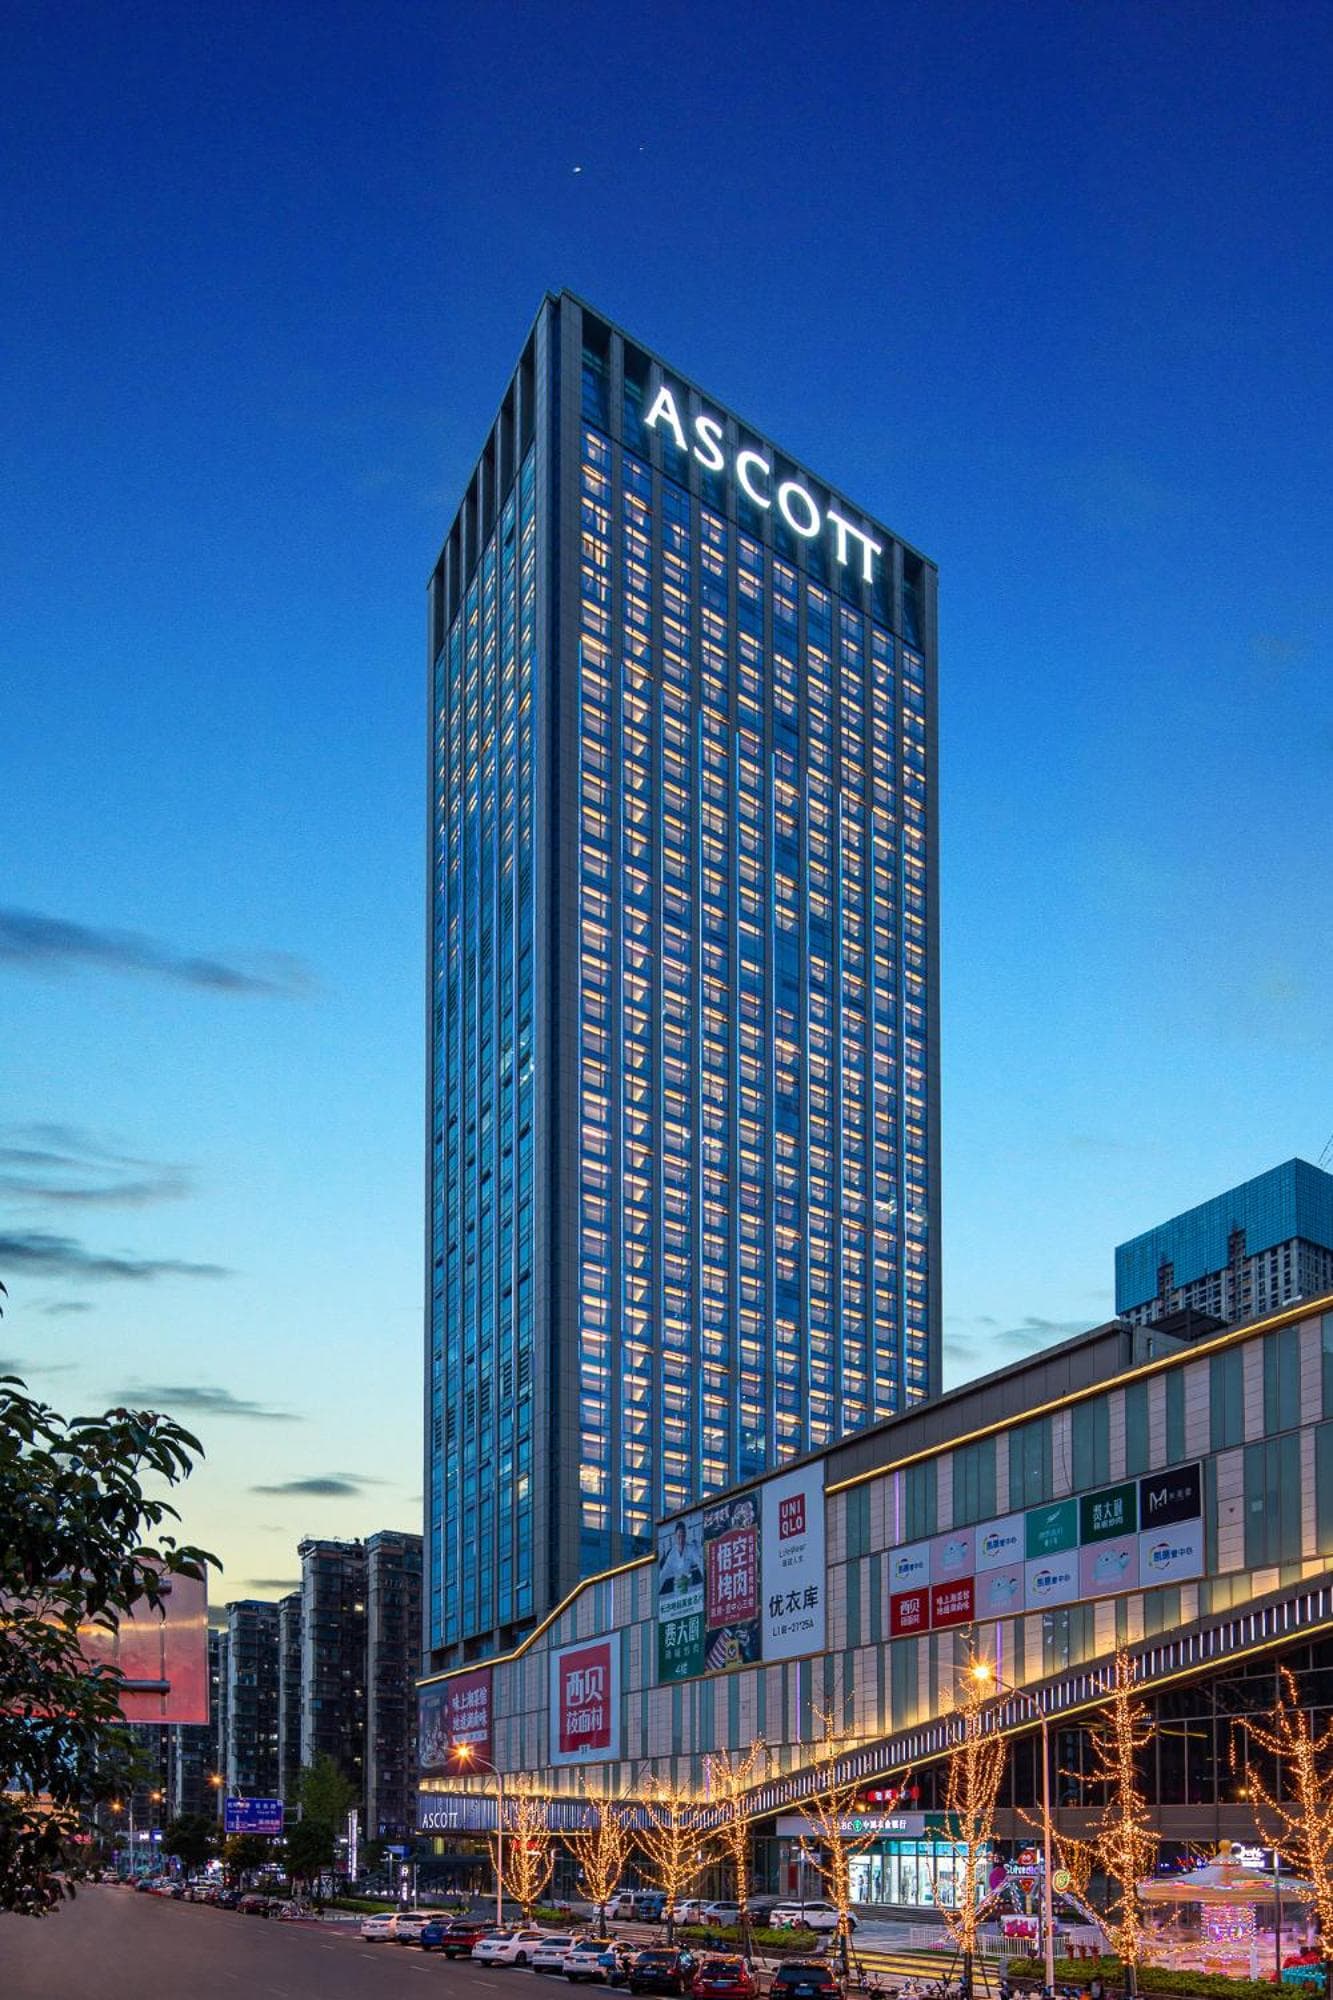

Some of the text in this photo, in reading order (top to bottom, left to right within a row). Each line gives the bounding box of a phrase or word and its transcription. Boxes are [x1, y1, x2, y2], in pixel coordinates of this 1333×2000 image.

[643, 385, 882, 584] ASCOTT
[781, 1501, 802, 1519] UNI
[781, 1516, 803, 1537] QLO
[717, 1535, 747, 1573] 悟空
[717, 1569, 748, 1603] 烤肉
[768, 1586, 819, 1619] 优衣库
[664, 1616, 700, 1648] 费大厨
[565, 1665, 604, 1707] 西贝
[422, 1811, 459, 1829] ASCOTT
